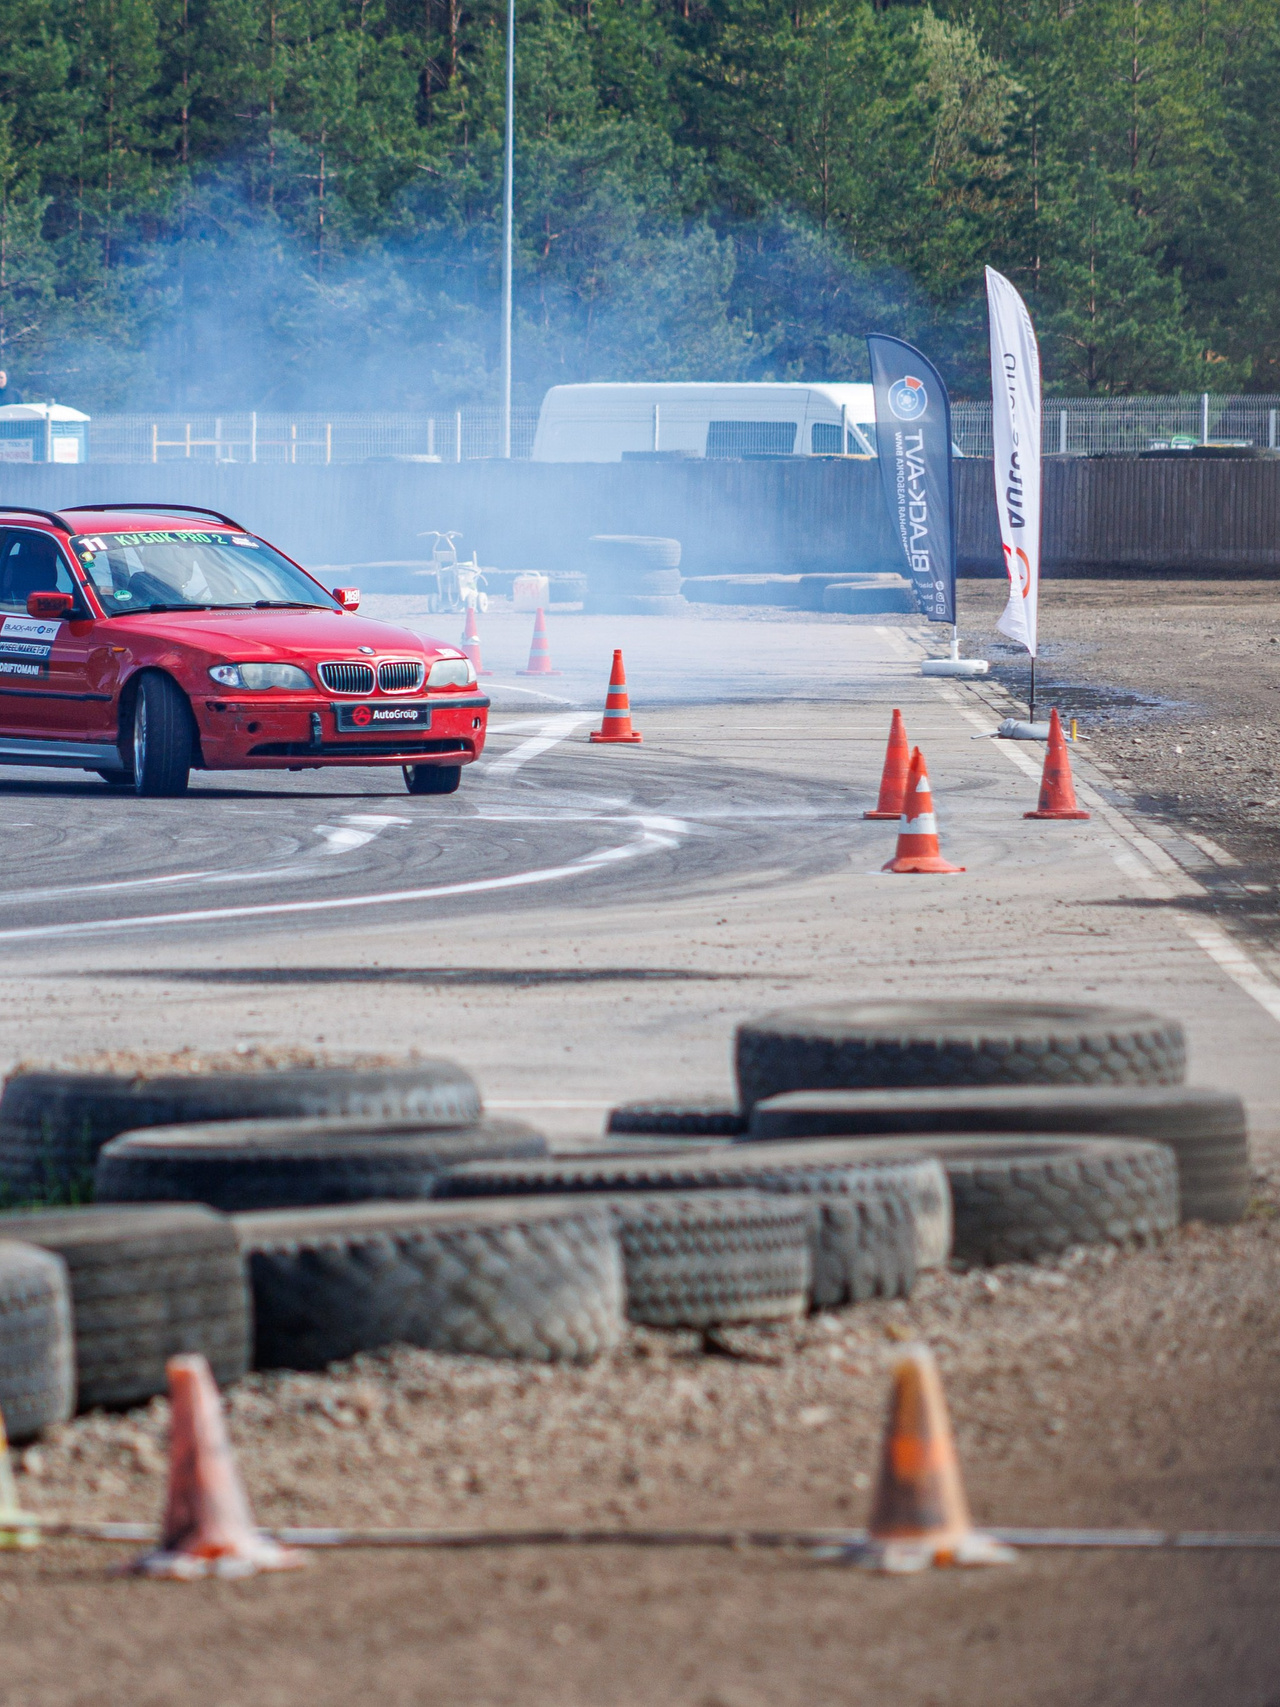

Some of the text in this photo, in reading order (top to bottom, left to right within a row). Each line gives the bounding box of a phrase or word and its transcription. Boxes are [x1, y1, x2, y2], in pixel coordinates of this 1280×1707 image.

[78, 536, 108, 551] 11
[114, 532, 177, 546] КУБОК
[175, 532, 212, 543] PRO
[212, 534, 228, 545] 2
[373, 709, 418, 720] AutoGroup
